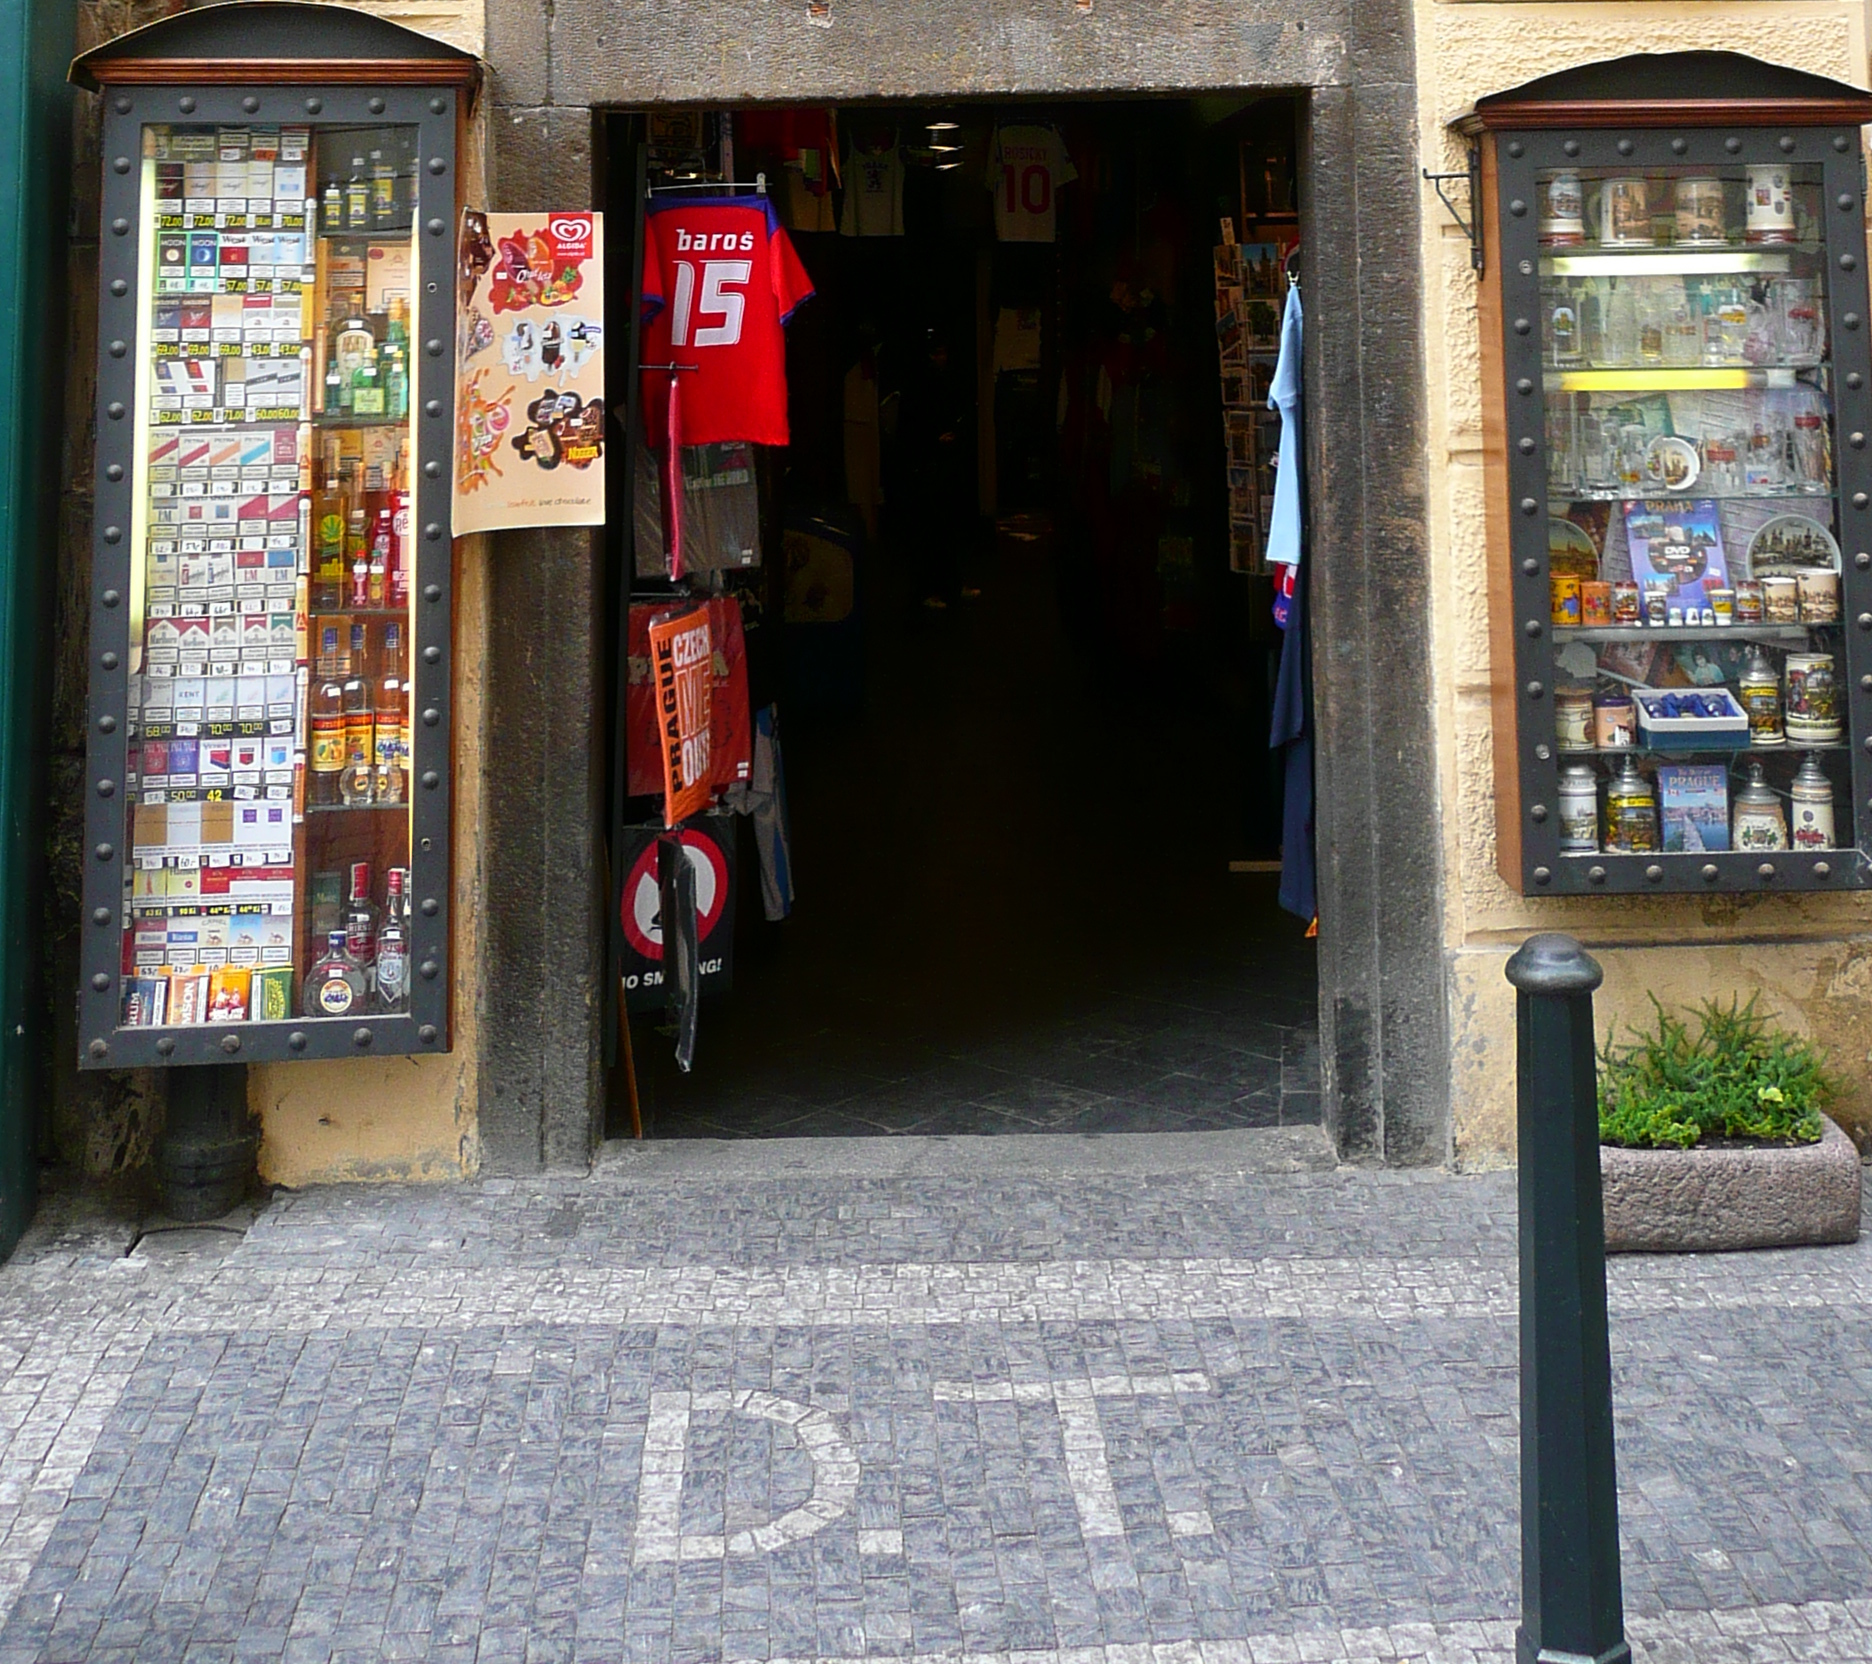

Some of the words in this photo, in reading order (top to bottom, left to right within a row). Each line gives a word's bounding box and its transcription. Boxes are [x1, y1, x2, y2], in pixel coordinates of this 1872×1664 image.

[1002, 164, 1050, 214] 10
[676, 229, 754, 250] baroš
[671, 260, 752, 347] 15
[1645, 500, 1694, 513] PRAHA
[1664, 546, 1691, 554] DVD
[657, 637, 682, 793] PRAGUE
[1669, 776, 1720, 787] PRAGUE
[207, 790, 222, 801] 42
[643, 958, 722, 986] SMNG!
